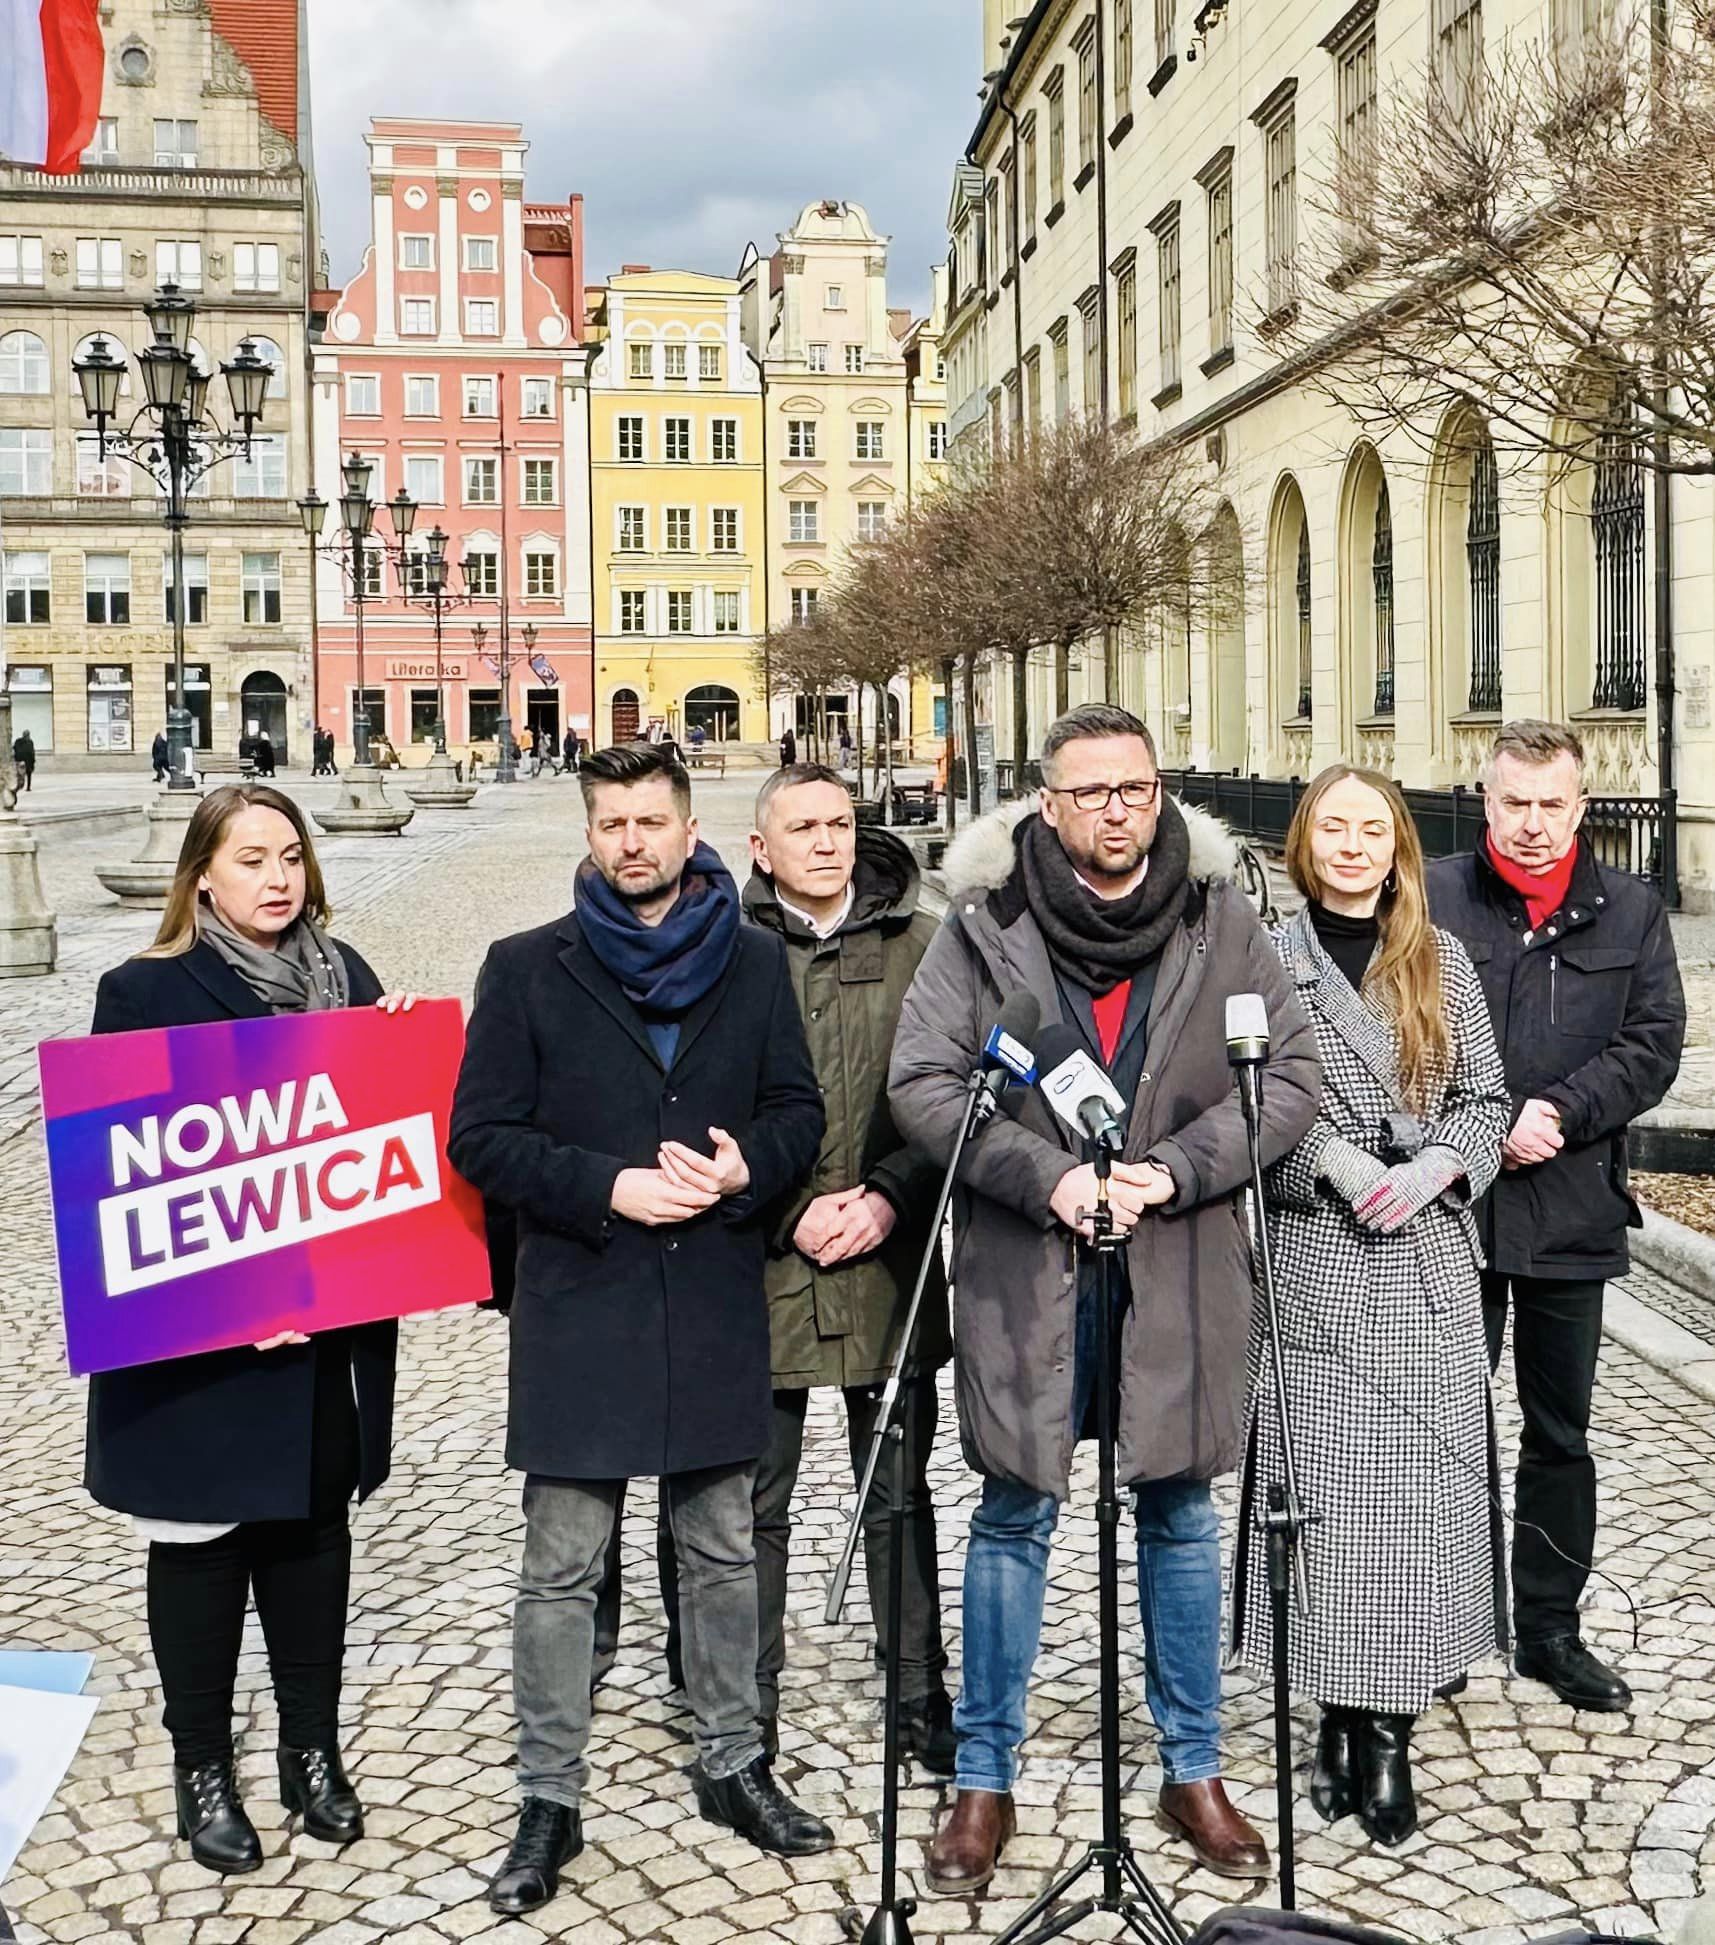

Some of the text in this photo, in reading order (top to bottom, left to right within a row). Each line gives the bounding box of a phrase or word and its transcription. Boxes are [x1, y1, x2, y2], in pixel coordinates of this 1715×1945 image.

[392, 662, 461, 676] Literaka
[110, 1073, 349, 1187] NOWA
[126, 1136, 424, 1272] LEWICA
